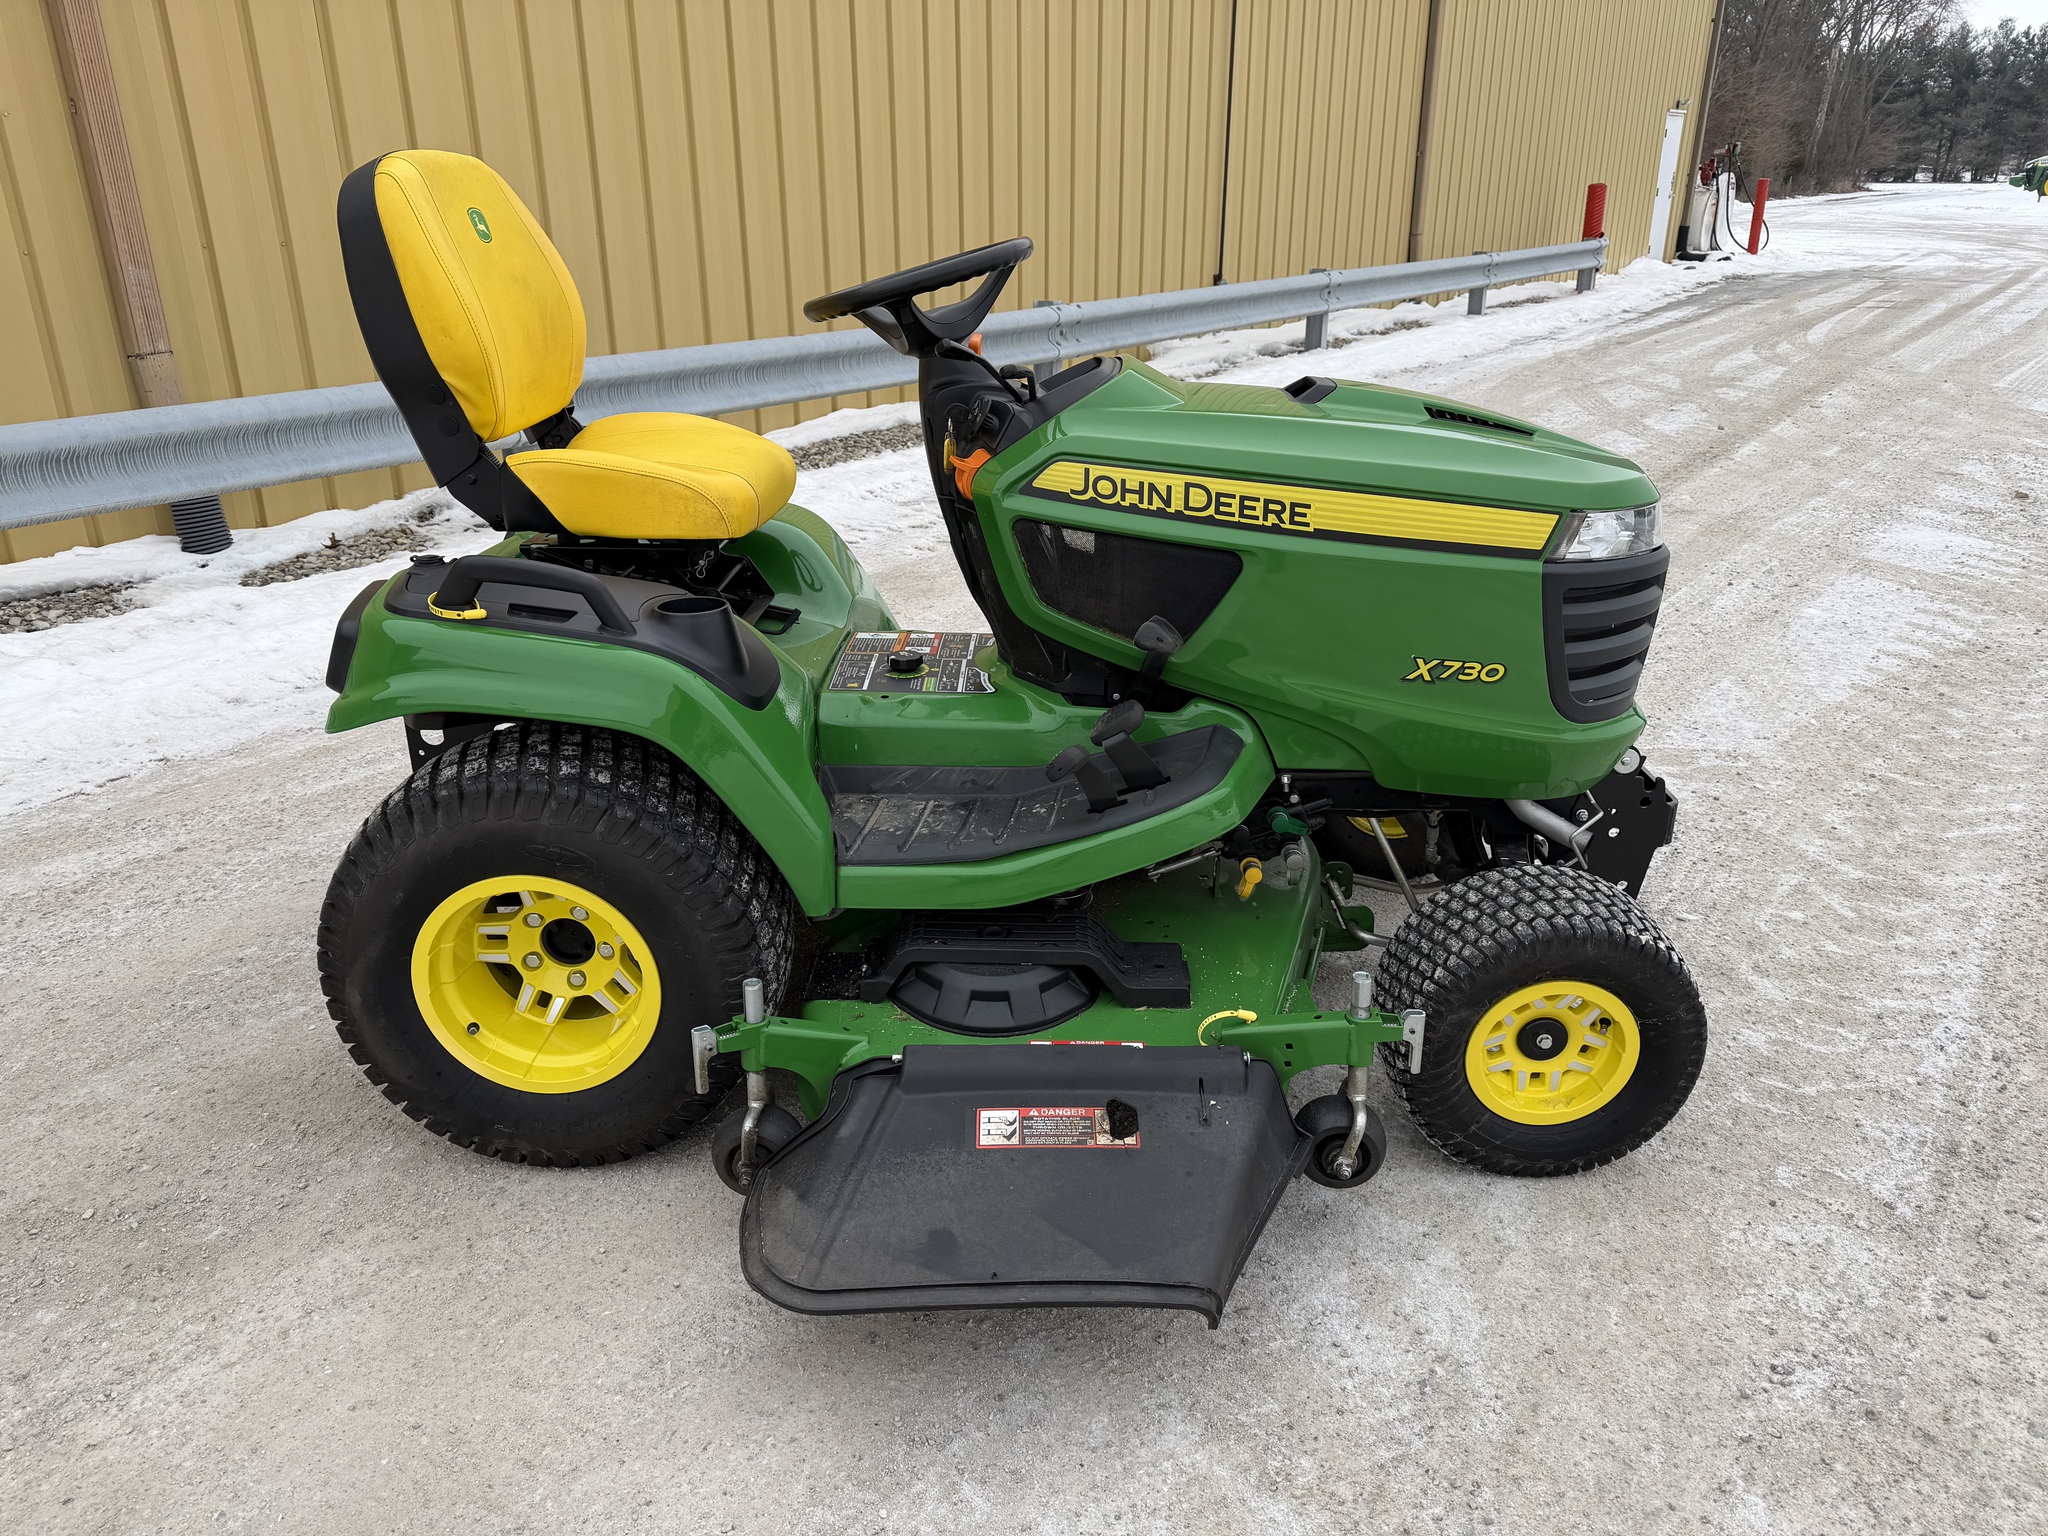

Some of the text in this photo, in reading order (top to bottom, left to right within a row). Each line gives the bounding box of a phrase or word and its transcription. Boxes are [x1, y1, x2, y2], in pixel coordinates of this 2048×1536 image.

[1069, 467, 1313, 529] JOHN DEERE
[1403, 657, 1507, 684] X730
[1041, 1108, 1086, 1116] DANGER
